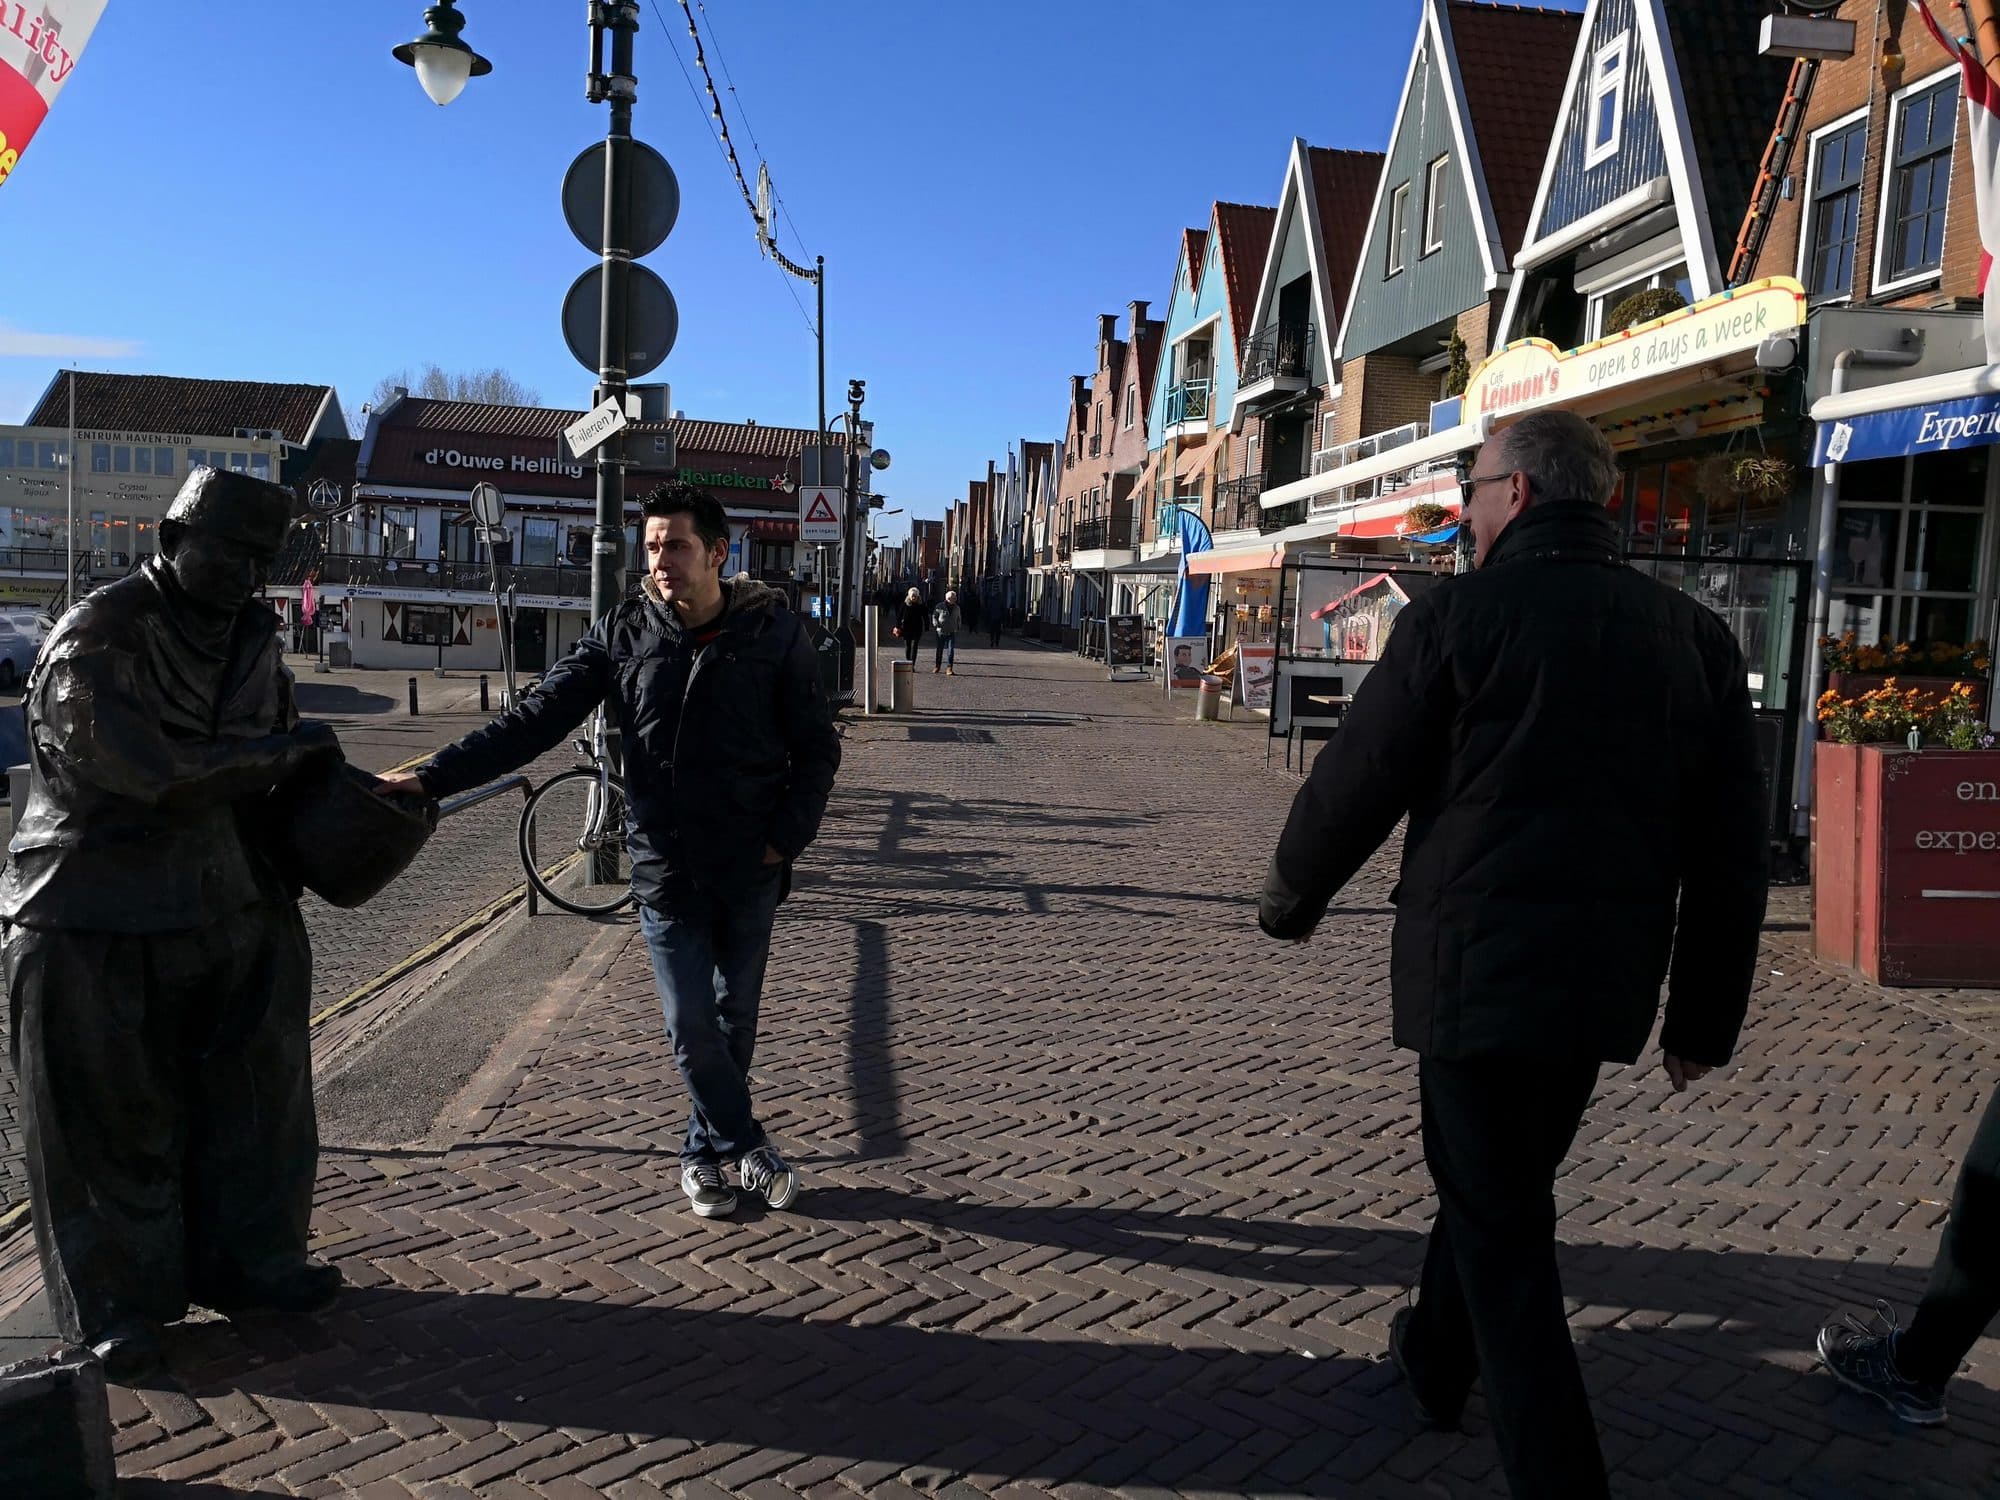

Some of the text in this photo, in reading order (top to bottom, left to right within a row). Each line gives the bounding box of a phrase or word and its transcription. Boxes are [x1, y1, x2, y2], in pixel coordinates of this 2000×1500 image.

[1587, 300, 1767, 387] open 8 days a week
[1480, 364, 1560, 414] Lennon's
[126, 433, 192, 446] HAVEN-ZUID
[568, 415, 610, 449] Tiletten
[425, 448, 583, 479] d'Ouwe Helling
[678, 467, 768, 489] Heineken
[1915, 829, 2000, 855] expe
